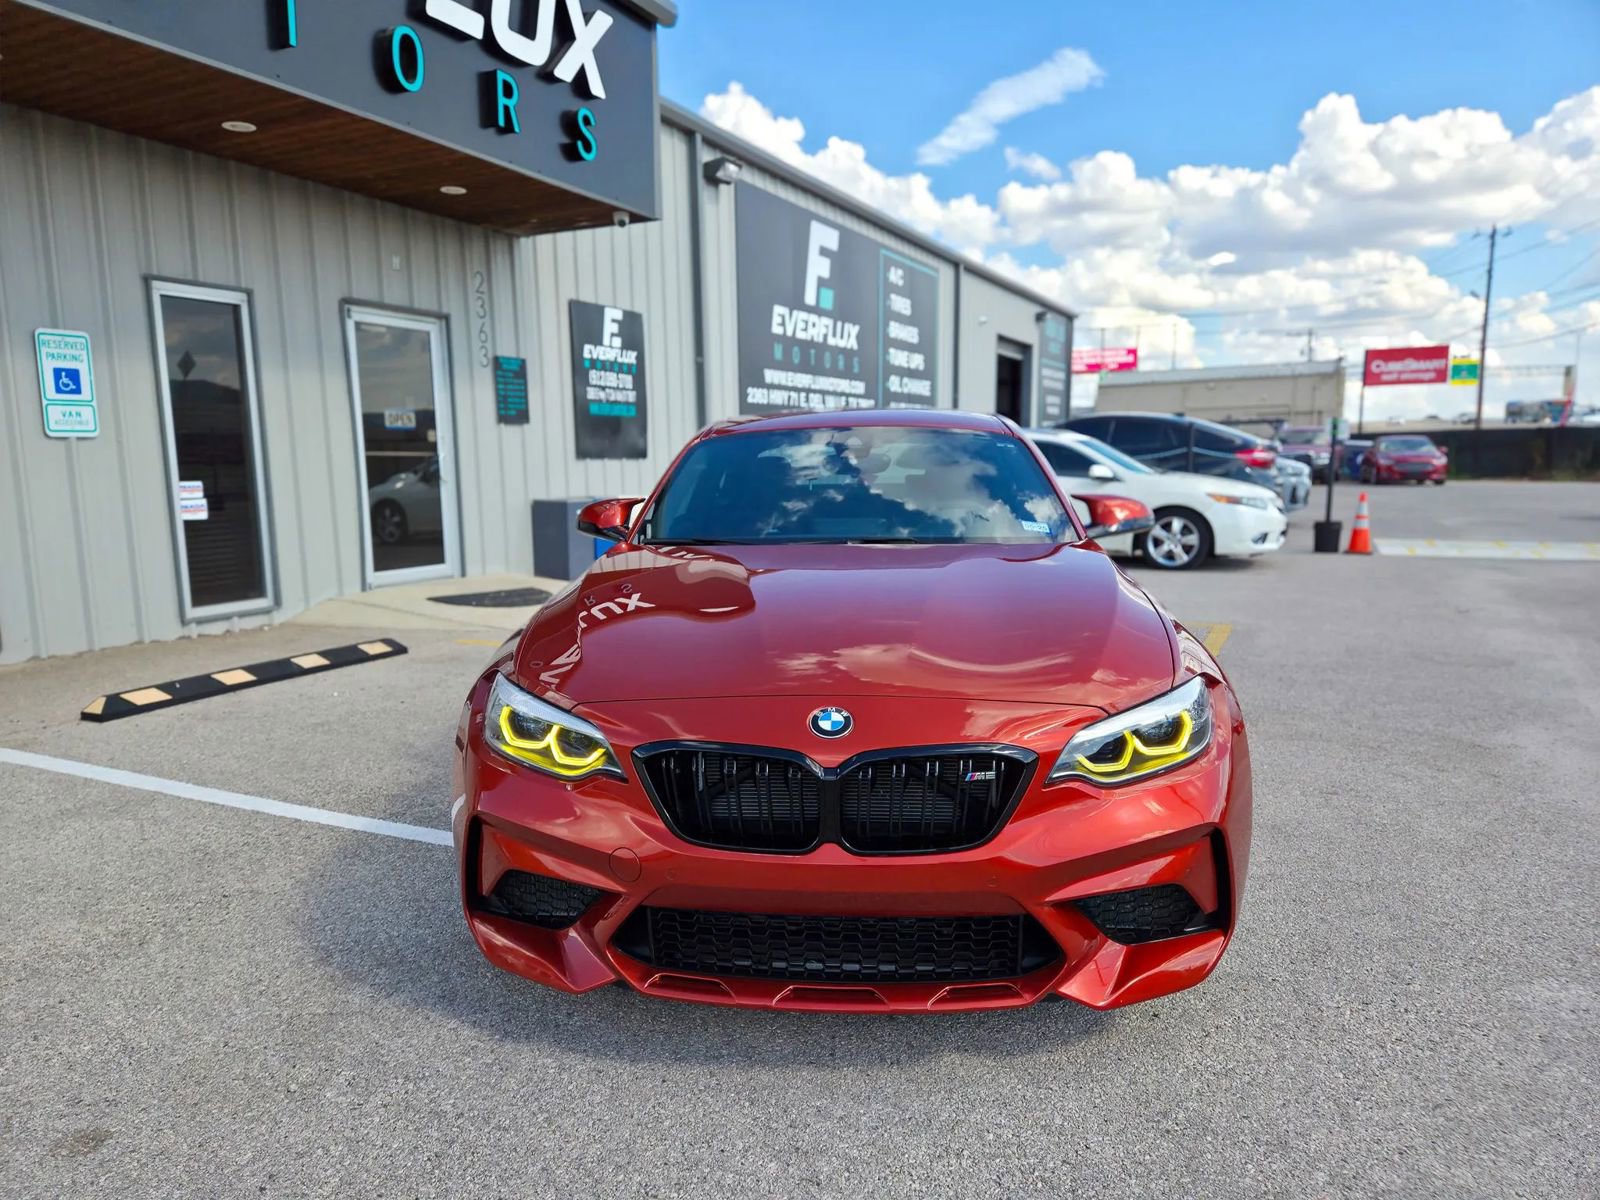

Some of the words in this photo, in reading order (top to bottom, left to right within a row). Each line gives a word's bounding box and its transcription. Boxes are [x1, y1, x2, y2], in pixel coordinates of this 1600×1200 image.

[771, 304, 860, 350] EVERFLUX
[41, 339, 85, 351] RESERVED
[46, 352, 83, 362] PARKING
[583, 344, 638, 364] EVERFLUX
[773, 342, 860, 373] MOTORS
[815, 707, 849, 717] BMW
